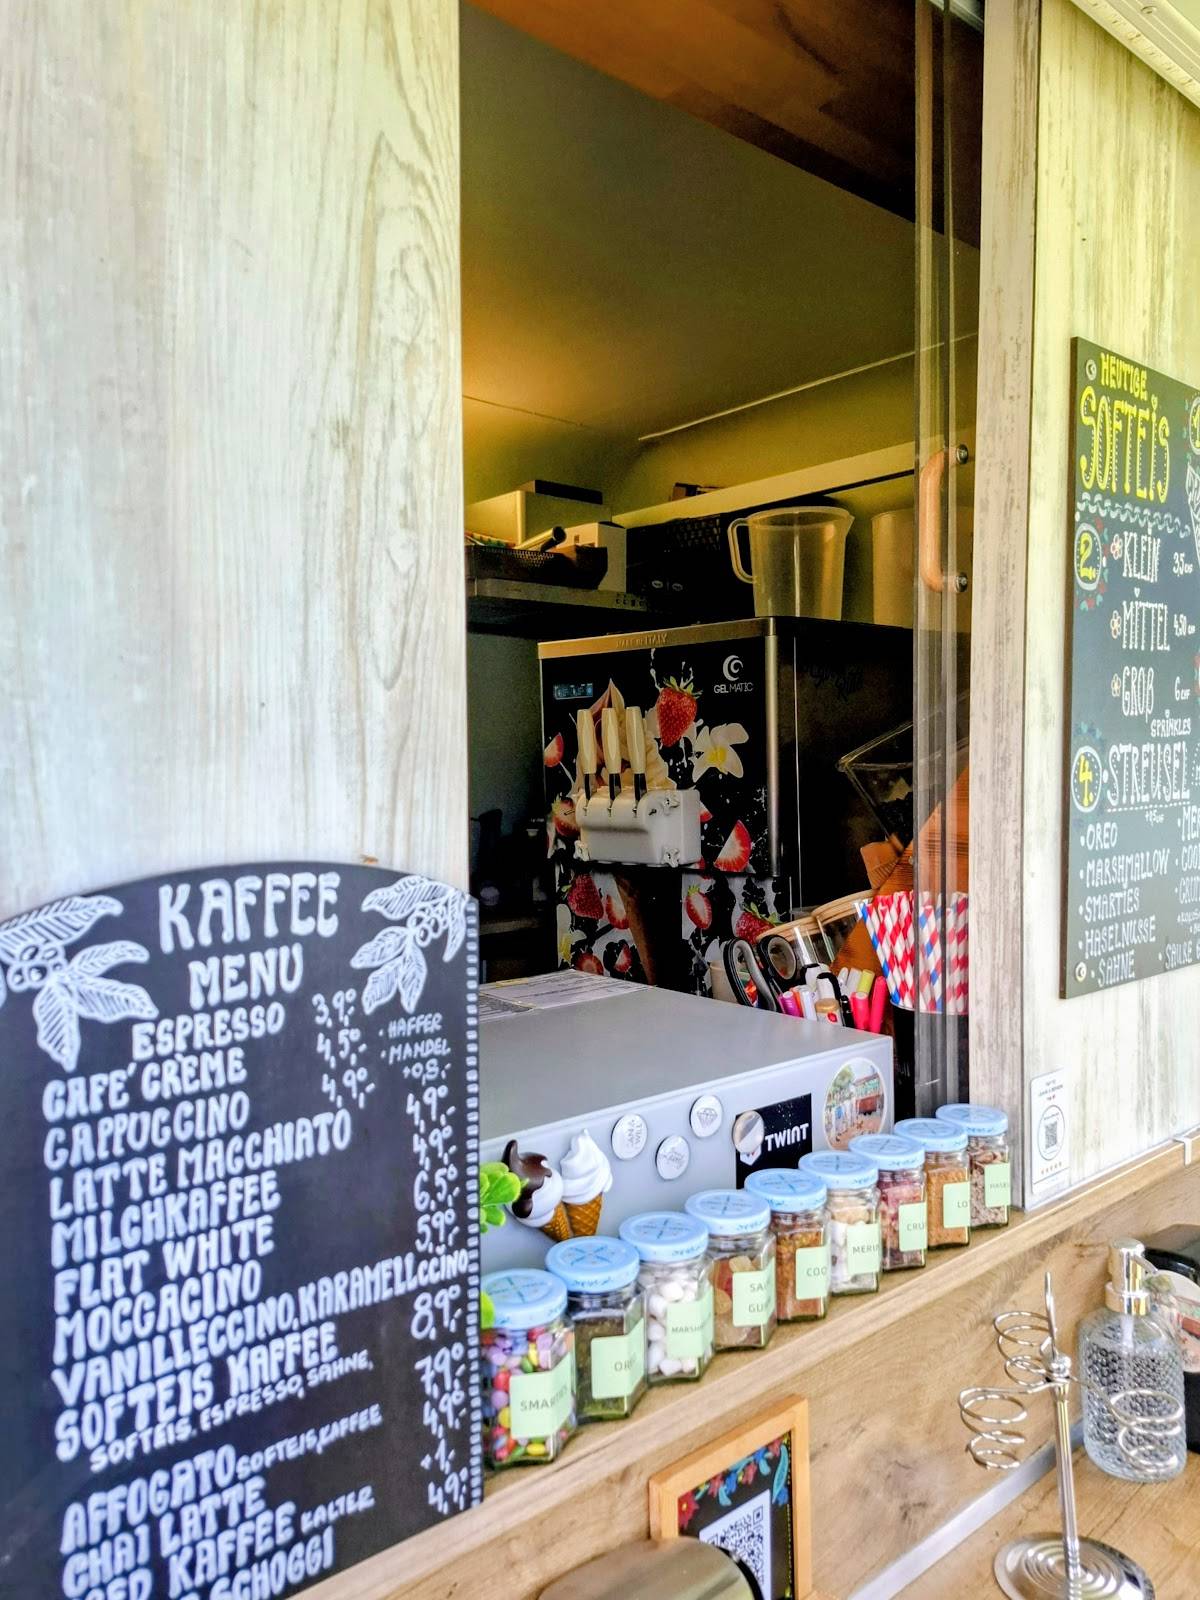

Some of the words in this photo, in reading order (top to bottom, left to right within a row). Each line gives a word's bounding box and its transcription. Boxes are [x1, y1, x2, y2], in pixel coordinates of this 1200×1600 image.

[1100, 352, 1148, 401] HEUTIGE
[1122, 530, 1161, 583] KLEIN
[1122, 600, 1171, 651] MITTEL
[1151, 710, 1191, 737] SPRINKLES
[1107, 741, 1190, 806] STREUSEL
[1086, 822, 1118, 850] OREO
[1086, 848, 1170, 889] MARSHMALLOW
[158, 872, 341, 953] KAFFEE
[1084, 887, 1140, 923] SMARTIES
[188, 942, 303, 1011] MENU
[1098, 949, 1135, 987] SAHNE
[132, 1002, 285, 1061] ESPRESSO
[389, 1037, 451, 1065] MANDEL
[43, 1091, 251, 1171] CAPPUCCINO
[764, 1122, 809, 1151] TWINT
[50, 1153, 168, 1221] LATTE
[177, 1108, 351, 1189] MACCHIATO
[50, 1170, 281, 1269] MILCHKAFFEE
[54, 1249, 150, 1316] FLAT
[162, 1214, 275, 1280] WHITE
[53, 1260, 262, 1366] MOCCACINO
[55, 1362, 214, 1462] SOFTEIS
[227, 1321, 339, 1397] KAFFEE
[60, 1444, 237, 1554] AFFOGATO
[62, 1524, 150, 1598] CHAI
[159, 1476, 266, 1557] LATTE
[169, 1501, 296, 1599] KAFFEE
